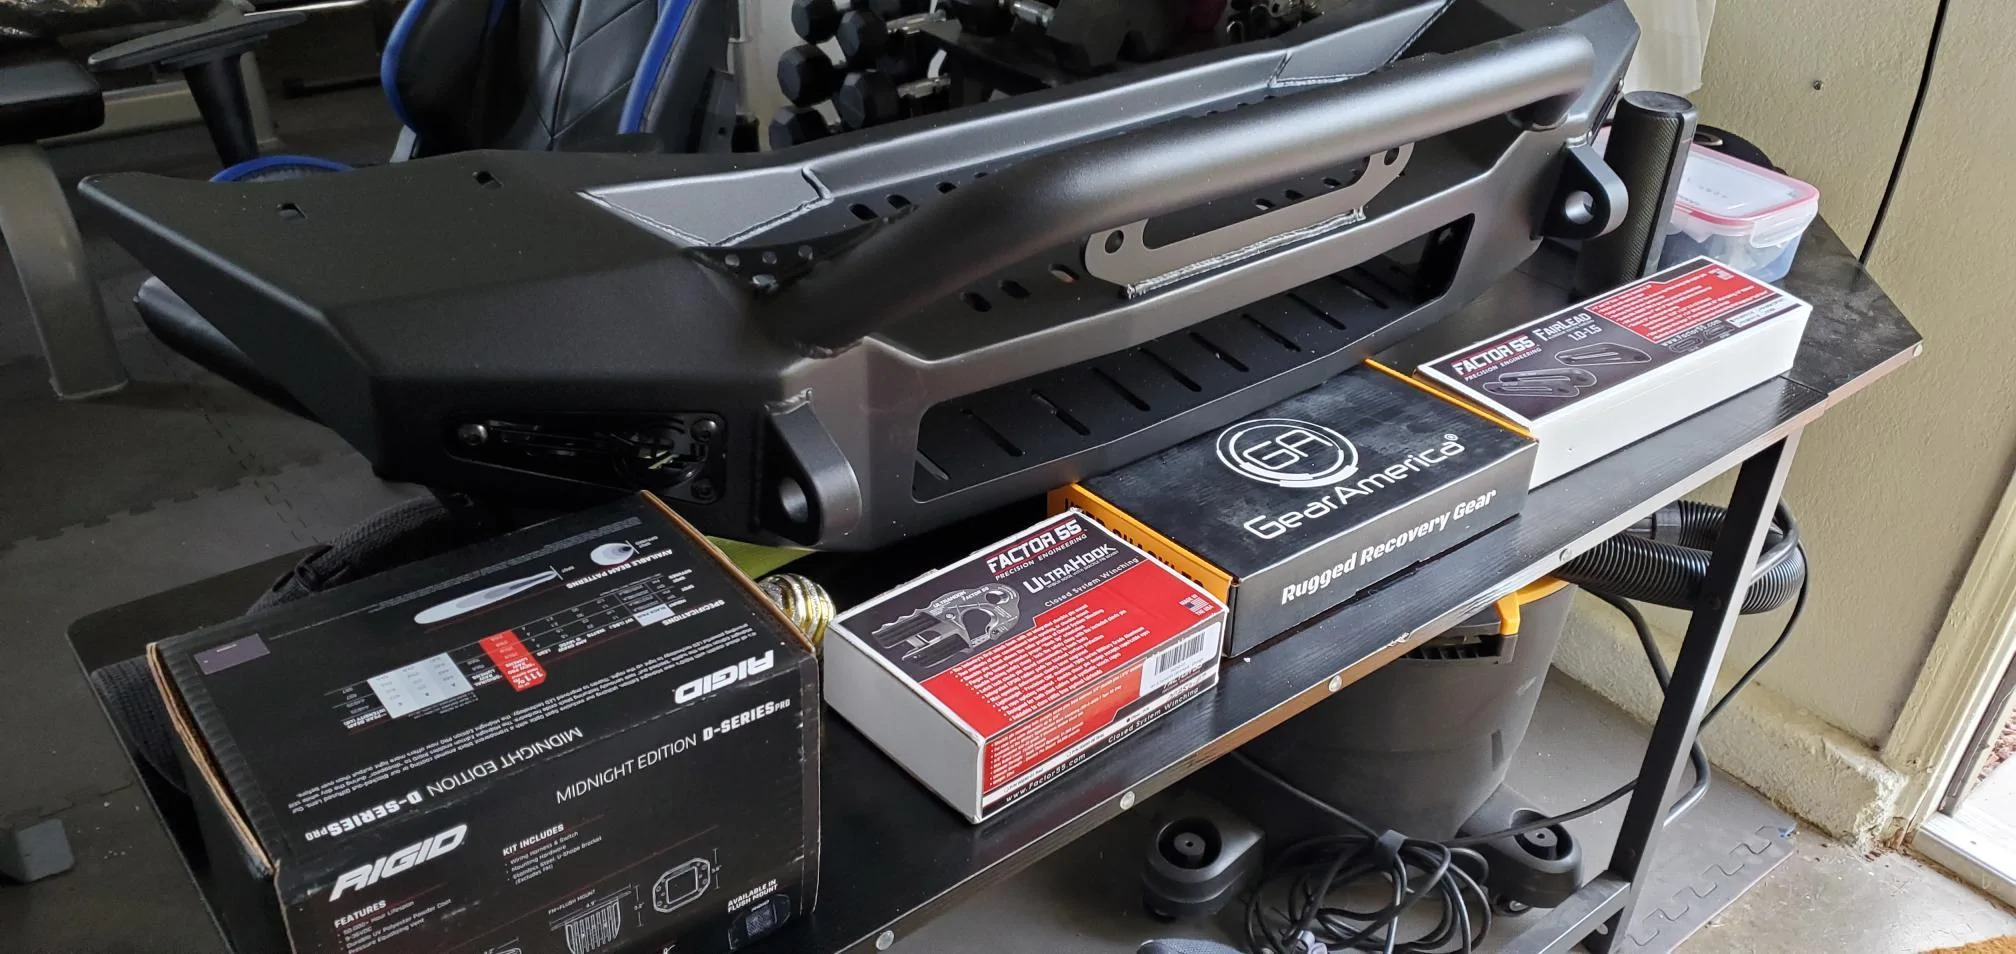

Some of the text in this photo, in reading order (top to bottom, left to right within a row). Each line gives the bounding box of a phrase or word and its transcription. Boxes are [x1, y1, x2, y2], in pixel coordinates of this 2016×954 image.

[1452, 335, 1534, 374] FACTOR 55
[1464, 347, 1541, 381] PRECISION ENGINEERING
[1243, 430, 1321, 469] GA
[631, 549, 671, 565] AVAILABLE
[987, 519, 1081, 572] FACTOR 55
[995, 533, 1086, 580] PRECISION ENGINEERING
[1282, 490, 1496, 605] Rugged Recovery Gear
[566, 571, 607, 588] PATTERNS
[607, 563, 631, 574] BEAM
[1044, 557, 1138, 606] Closed System Winching
[662, 599, 724, 624] SPECIFICATIONS
[512, 671, 542, 684] 111%
[674, 650, 773, 702] RIGID
[500, 727, 582, 767] MIDNIGHT
[1006, 753, 1085, 801] www.Factor55.com
[1108, 724, 1133, 742] Closed
[1135, 709, 1160, 727] System
[1164, 687, 1198, 709] Winching
[426, 760, 497, 795] EDITION
[556, 760, 633, 803] MIDNIGHT
[638, 734, 696, 768] EDITION
[503, 824, 563, 855] KIT INCLUDES
[330, 825, 466, 899] RIGID
[510, 853, 528, 864] Wiring
[511, 844, 566, 871] Mounting Hardware
[728, 883, 767, 907] AVAILABLE
[728, 897, 752, 913] FLUSH
[751, 884, 778, 903] MOUNT
[334, 900, 385, 927] FEATURES
